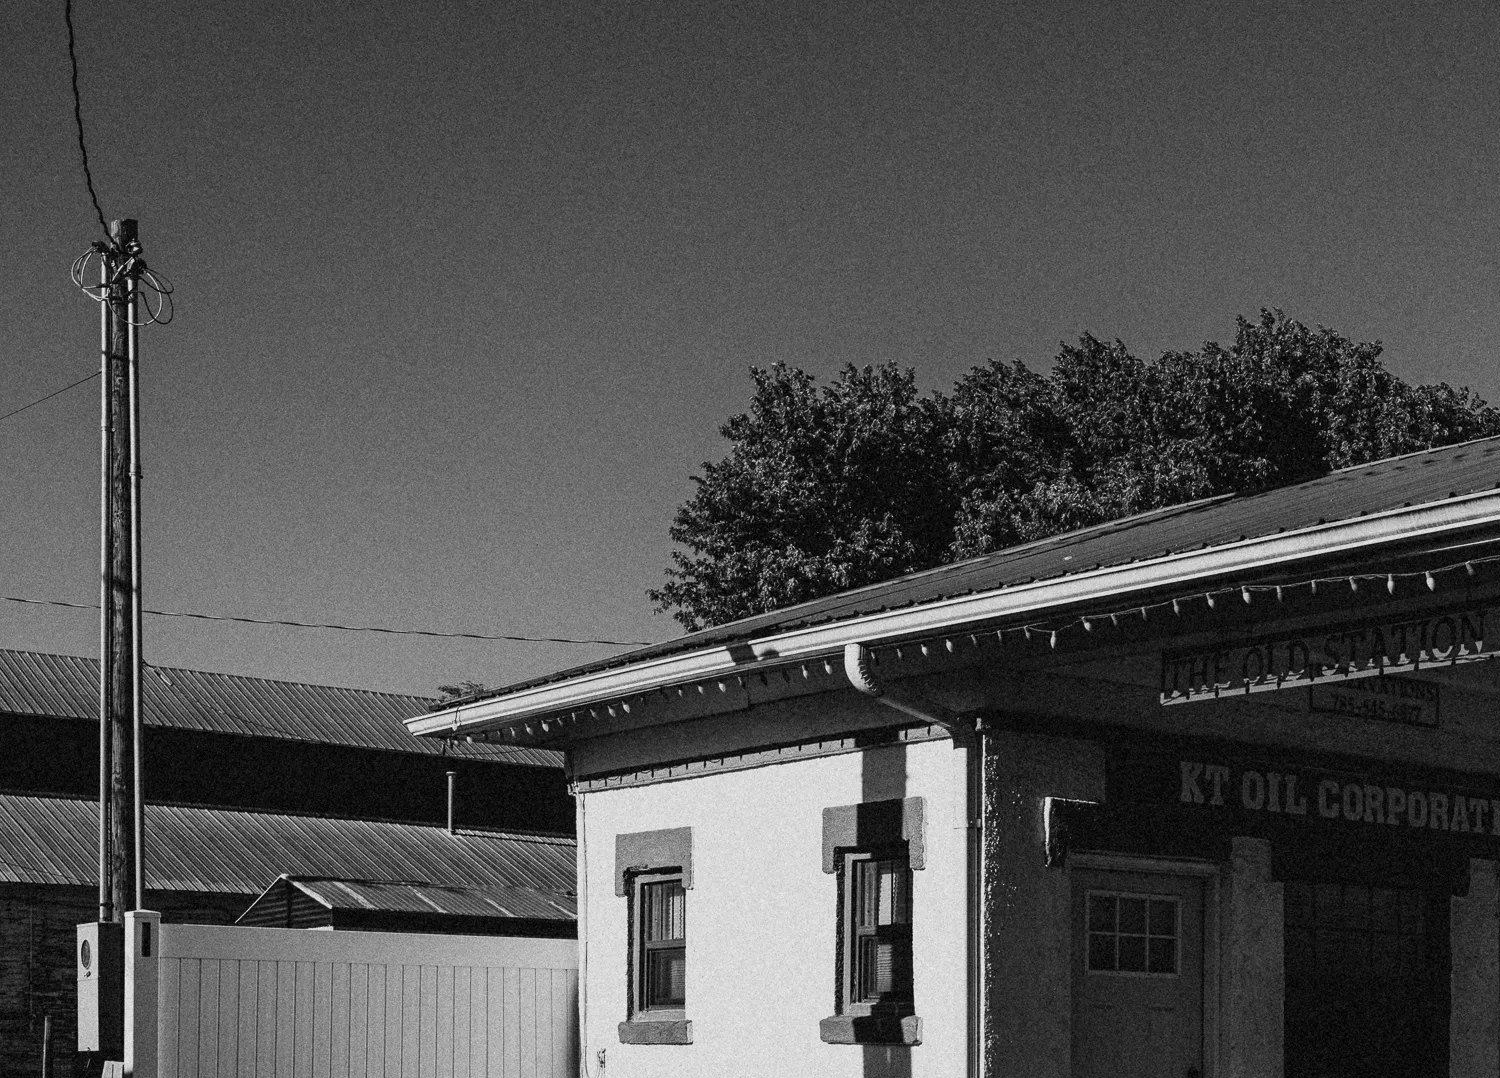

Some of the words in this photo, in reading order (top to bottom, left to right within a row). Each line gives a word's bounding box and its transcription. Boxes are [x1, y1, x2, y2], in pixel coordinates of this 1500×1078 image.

[1167, 650, 1232, 698] THE
[1242, 639, 1310, 684] OLD
[1323, 610, 1488, 676] STATION
[1179, 761, 1229, 805] KT
[1241, 771, 1307, 814] OIL
